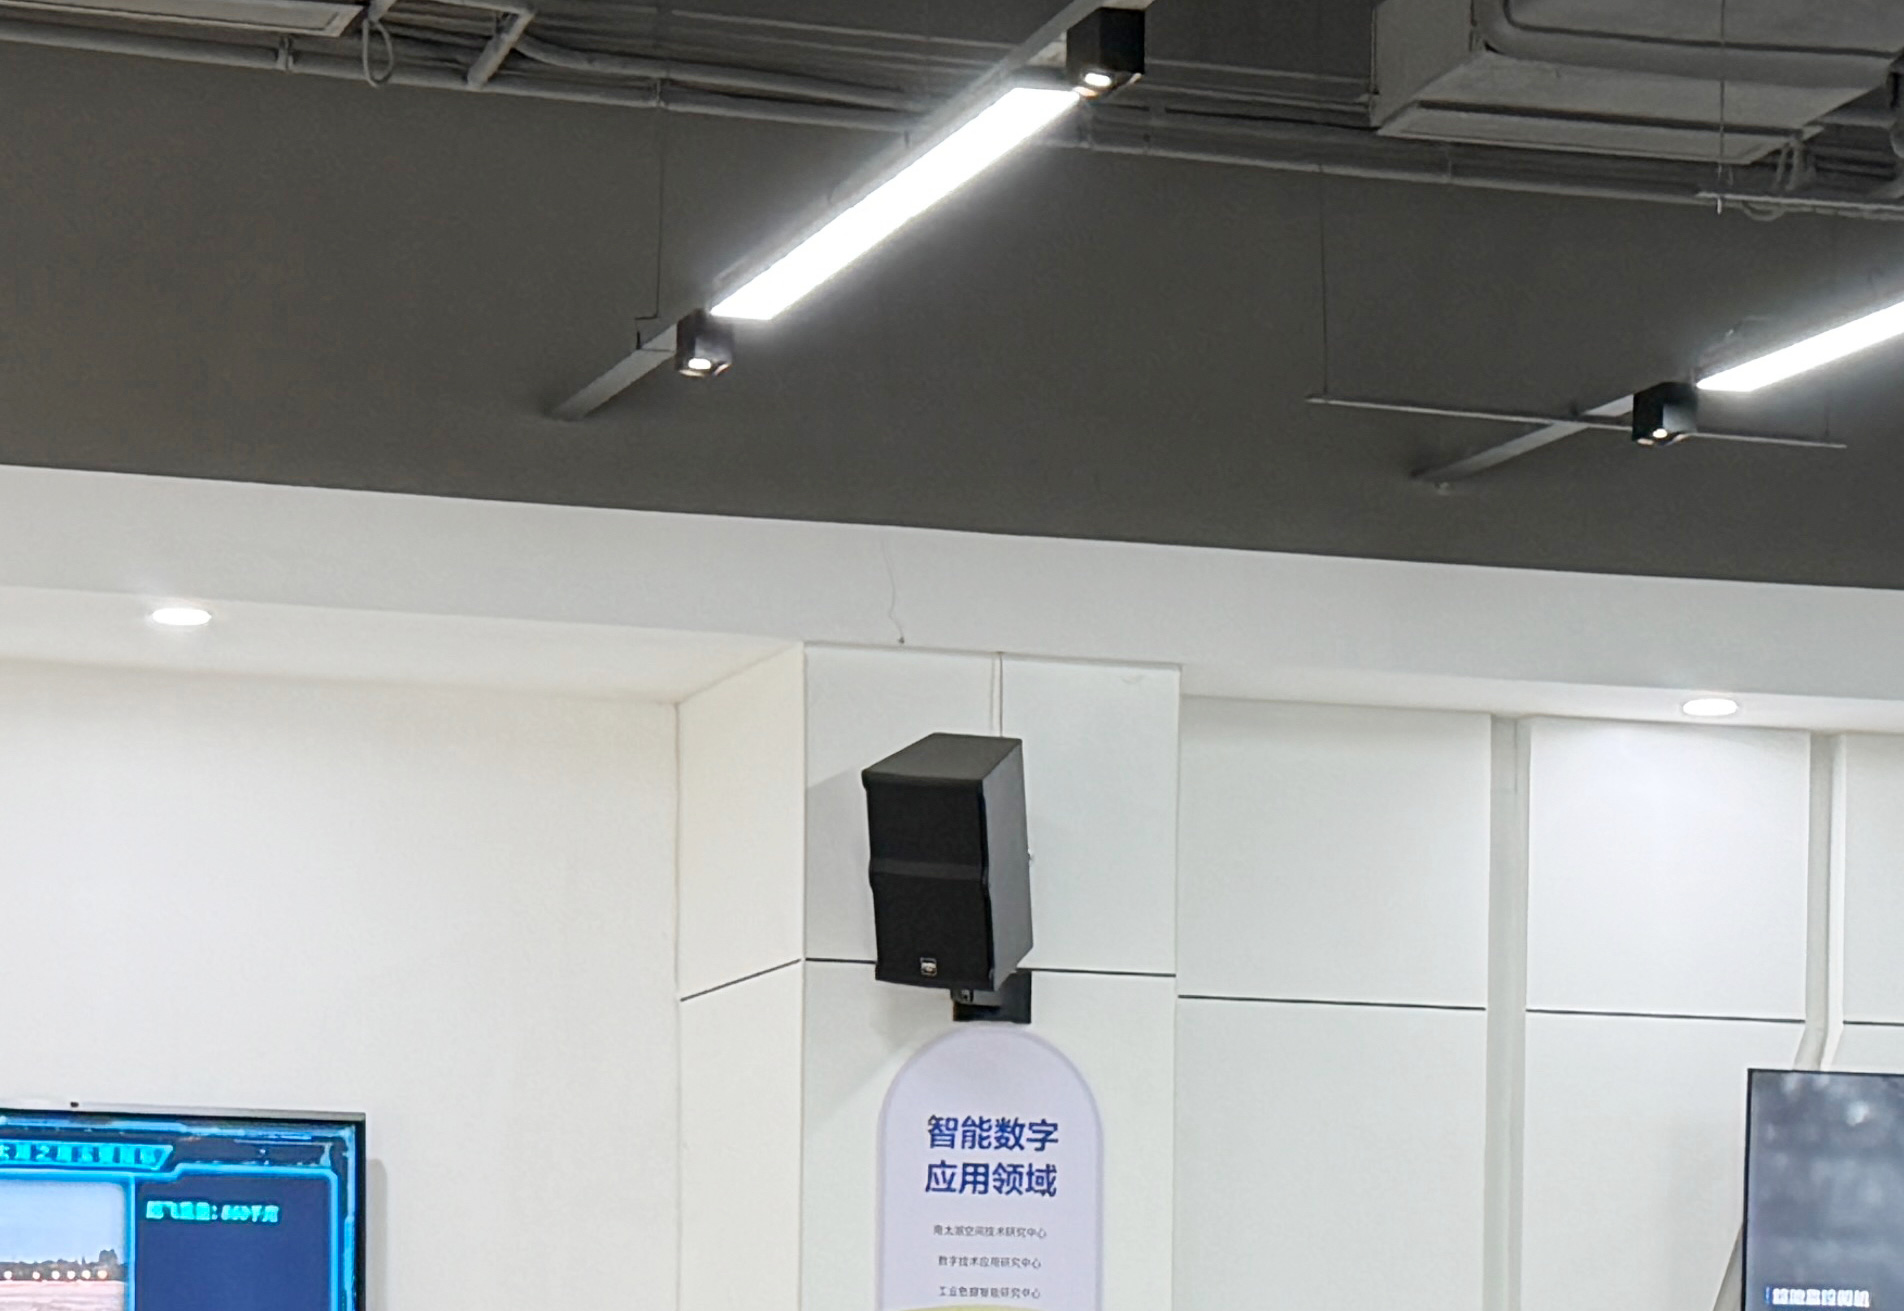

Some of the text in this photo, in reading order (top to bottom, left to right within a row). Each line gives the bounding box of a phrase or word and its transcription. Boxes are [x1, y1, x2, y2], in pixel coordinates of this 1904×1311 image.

[927, 1115, 1059, 1151] 智能数字
[925, 1160, 1058, 1197] 应用领域
